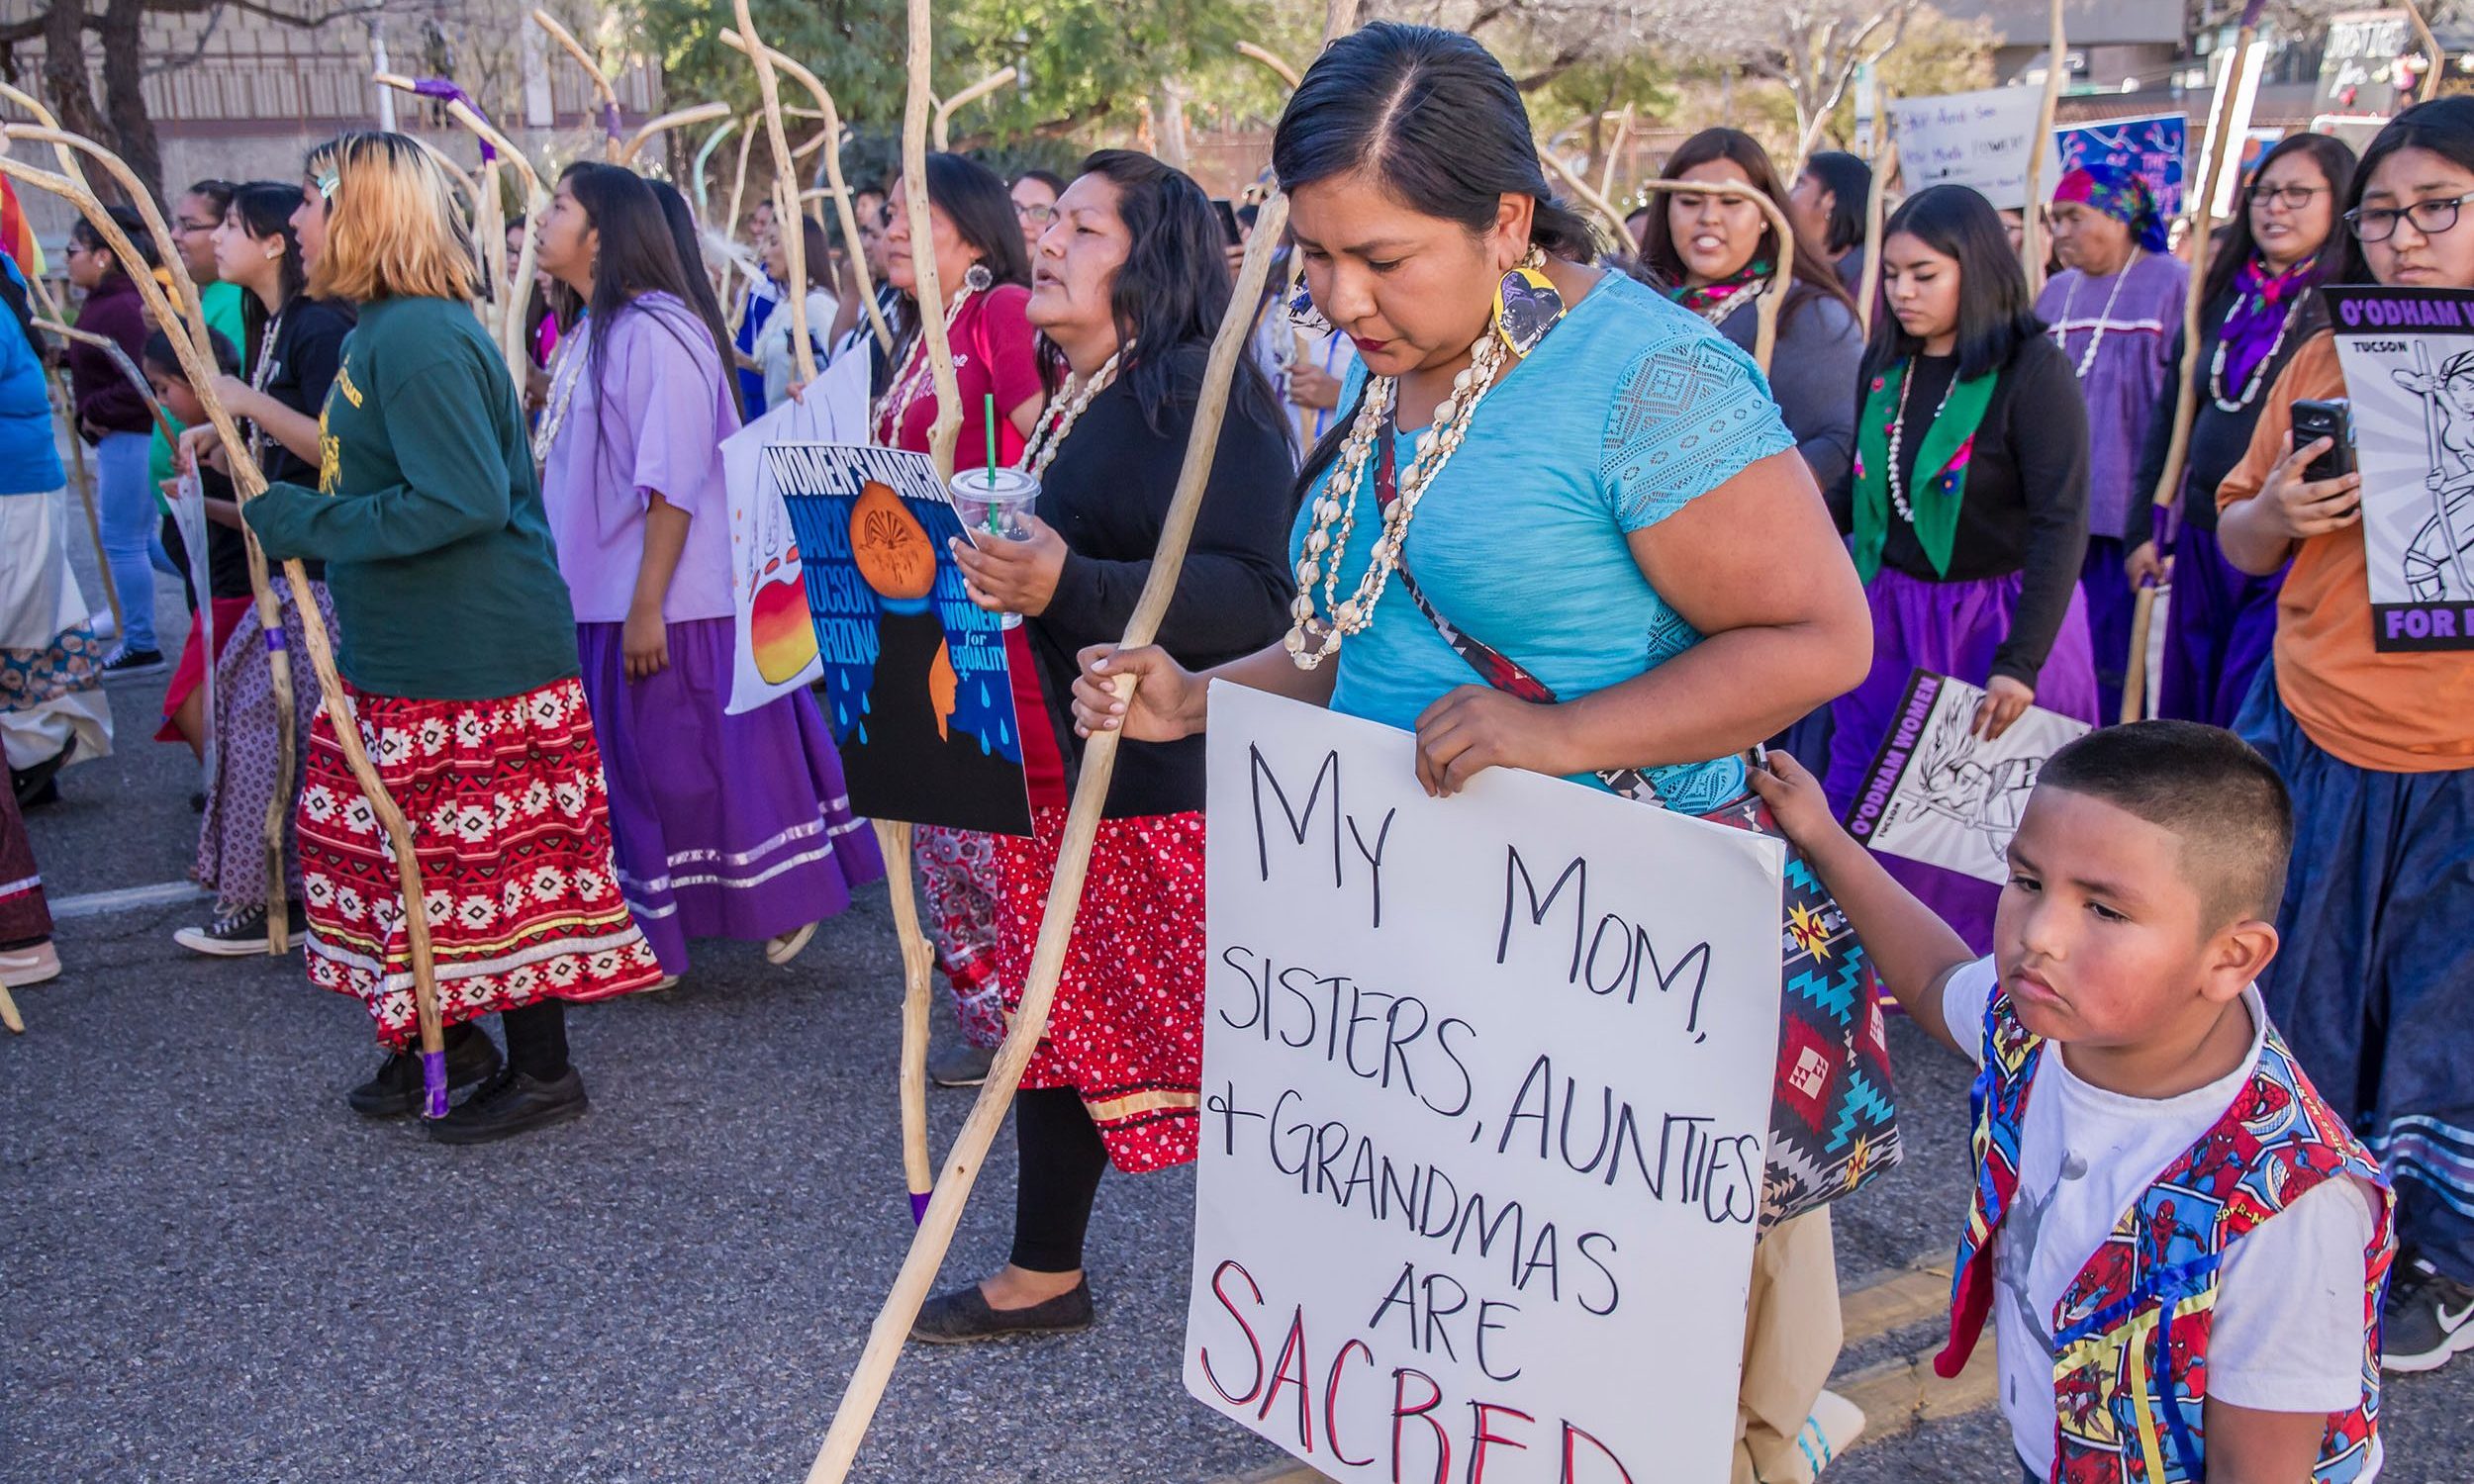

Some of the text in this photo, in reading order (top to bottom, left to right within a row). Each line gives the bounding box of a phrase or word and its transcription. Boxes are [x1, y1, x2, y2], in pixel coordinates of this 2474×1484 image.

[2338, 299, 2463, 327] O'ODHAM
[2352, 340, 2408, 353] TUCSON
[766, 447, 951, 504] WOMEN'S MARCH
[803, 564, 876, 614] TUCSON
[939, 601, 1002, 631] WOMEN
[2385, 608, 2457, 640] FOR
[811, 616, 881, 666] ARIZONA
[963, 626, 988, 650] for
[949, 646, 1008, 677] EQUALITY
[1851, 675, 1942, 835] O'ODHAM WOMEN
[1877, 802, 1901, 838] TUCSON
[1497, 1054, 1760, 1224] AUNTIES
[1270, 1089, 1619, 1316] GRANDMAS
[1369, 1261, 1521, 1382] ARE
